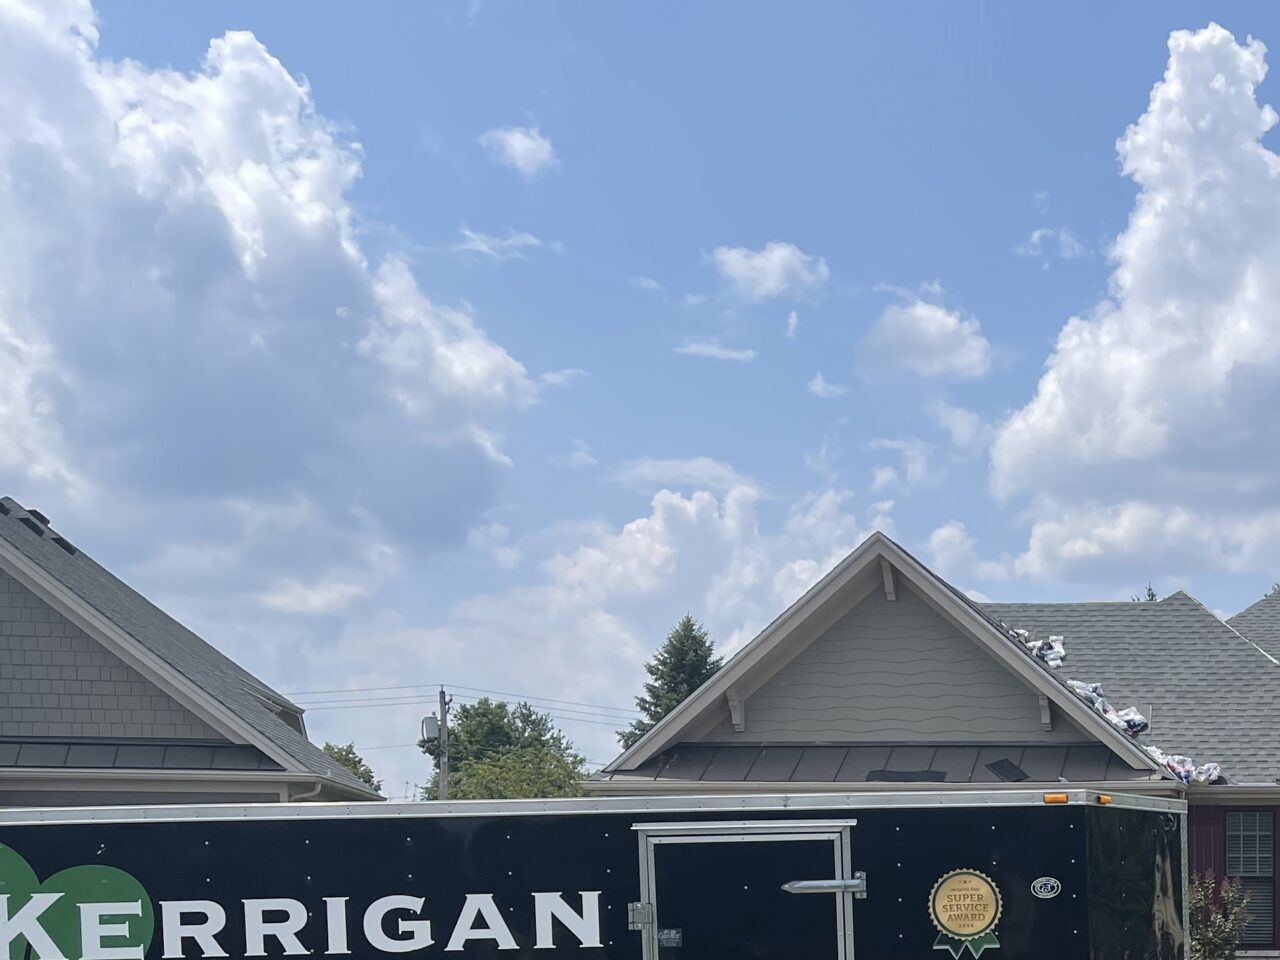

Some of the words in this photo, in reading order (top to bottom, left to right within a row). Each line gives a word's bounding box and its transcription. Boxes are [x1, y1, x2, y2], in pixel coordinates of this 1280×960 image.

[946, 893, 984, 903] SUPER
[942, 903, 989, 913] SERVICE
[946, 913, 986, 922] AWARD
